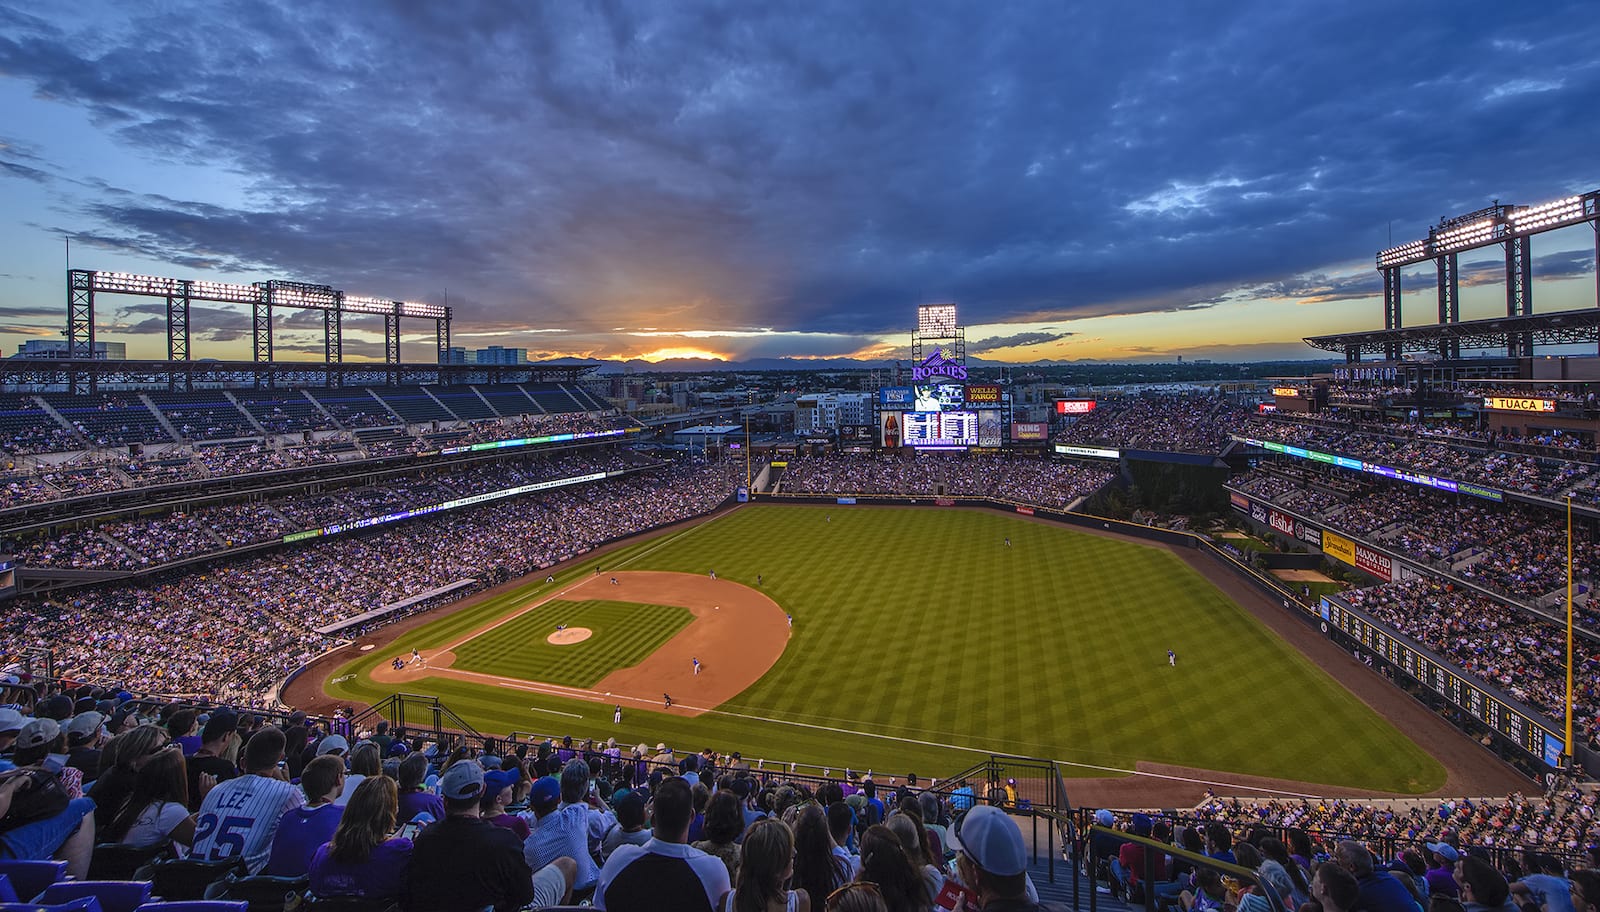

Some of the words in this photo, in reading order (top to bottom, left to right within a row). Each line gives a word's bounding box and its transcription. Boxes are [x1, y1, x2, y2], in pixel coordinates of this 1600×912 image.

[911, 366, 968, 380] ROCKIES
[1353, 367, 1397, 380] ROOFTOP
[1499, 399, 1537, 410] TUACA
[1017, 424, 1040, 432] KING
[1269, 511, 1288, 533] dish
[1356, 546, 1378, 564] MAXX
[1378, 553, 1391, 568] HD
[216, 791, 253, 810] LEE
[189, 812, 256, 861] 25
